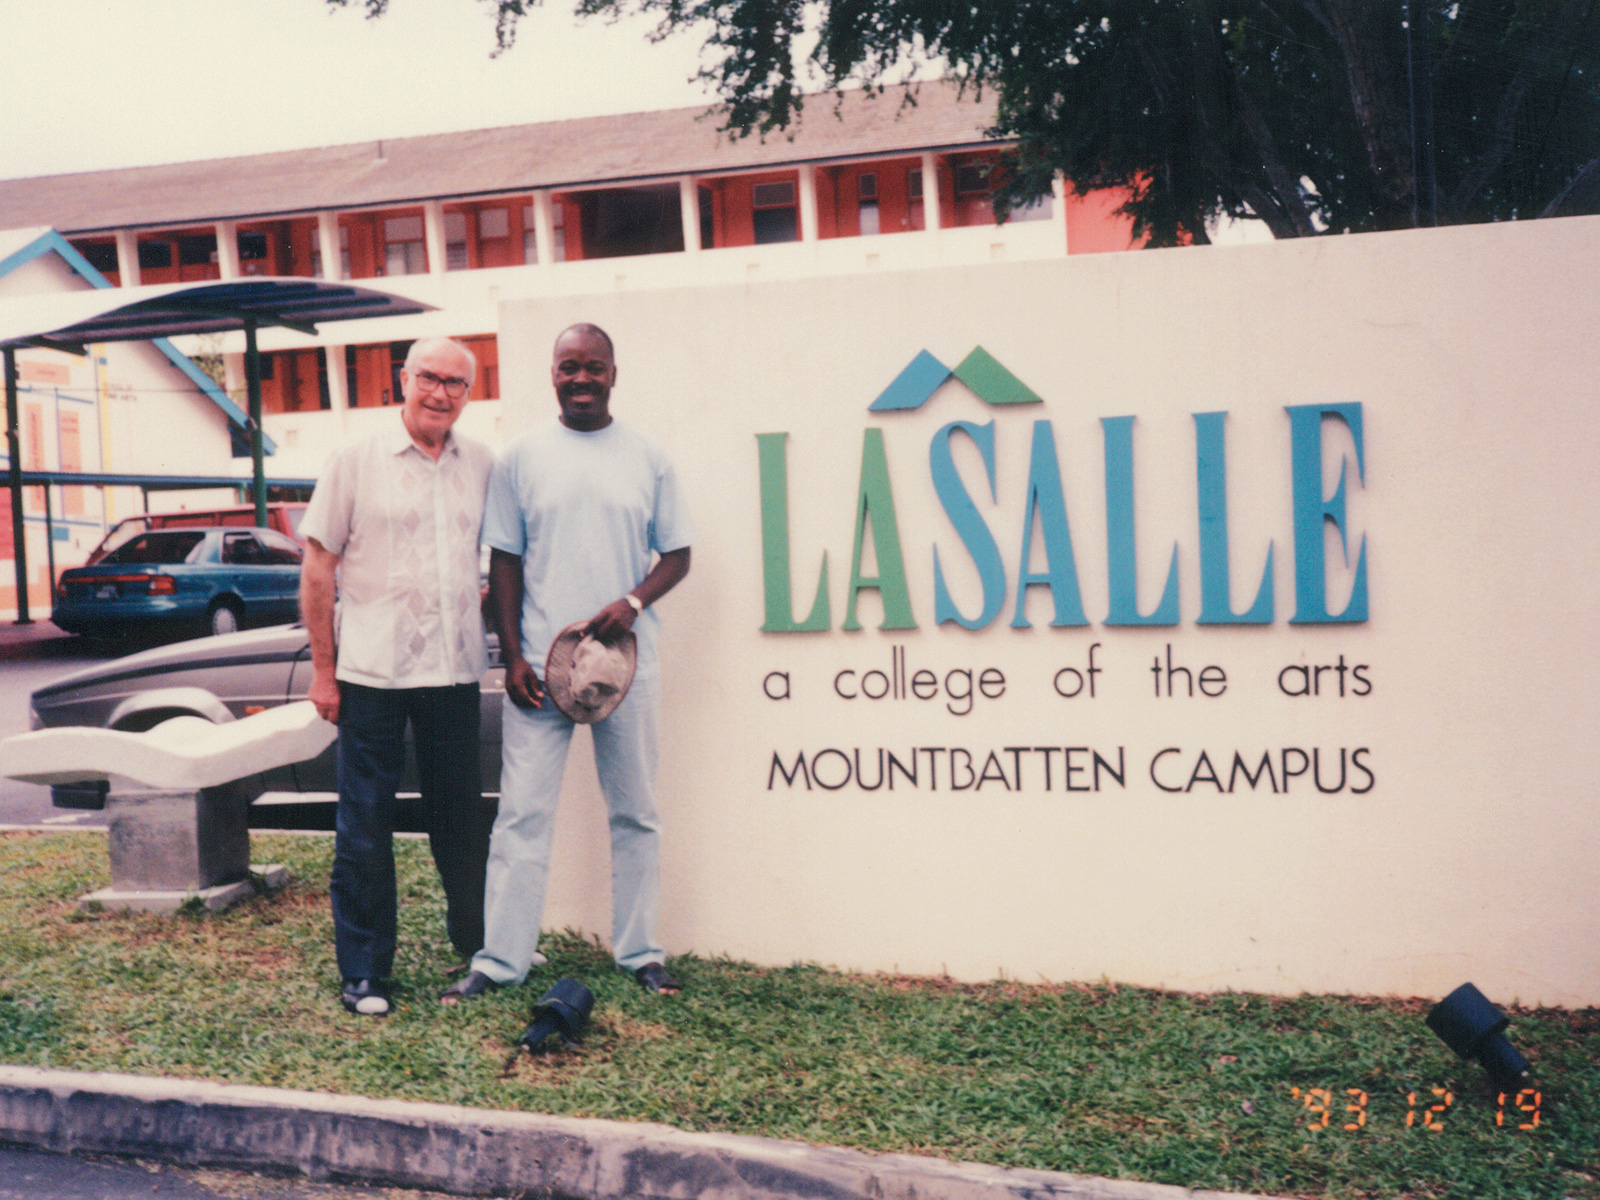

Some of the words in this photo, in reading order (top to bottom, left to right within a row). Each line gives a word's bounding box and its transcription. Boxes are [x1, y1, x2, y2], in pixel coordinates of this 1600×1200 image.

[755, 401, 1370, 632] LASALLE
[762, 671, 791, 701] a
[834, 644, 1006, 717] college
[1054, 643, 1102, 699] of
[1150, 643, 1228, 698] the
[1277, 653, 1373, 698] arts
[767, 746, 1126, 792] MOUNTBATTEN
[1149, 747, 1375, 795] CAMPUS
